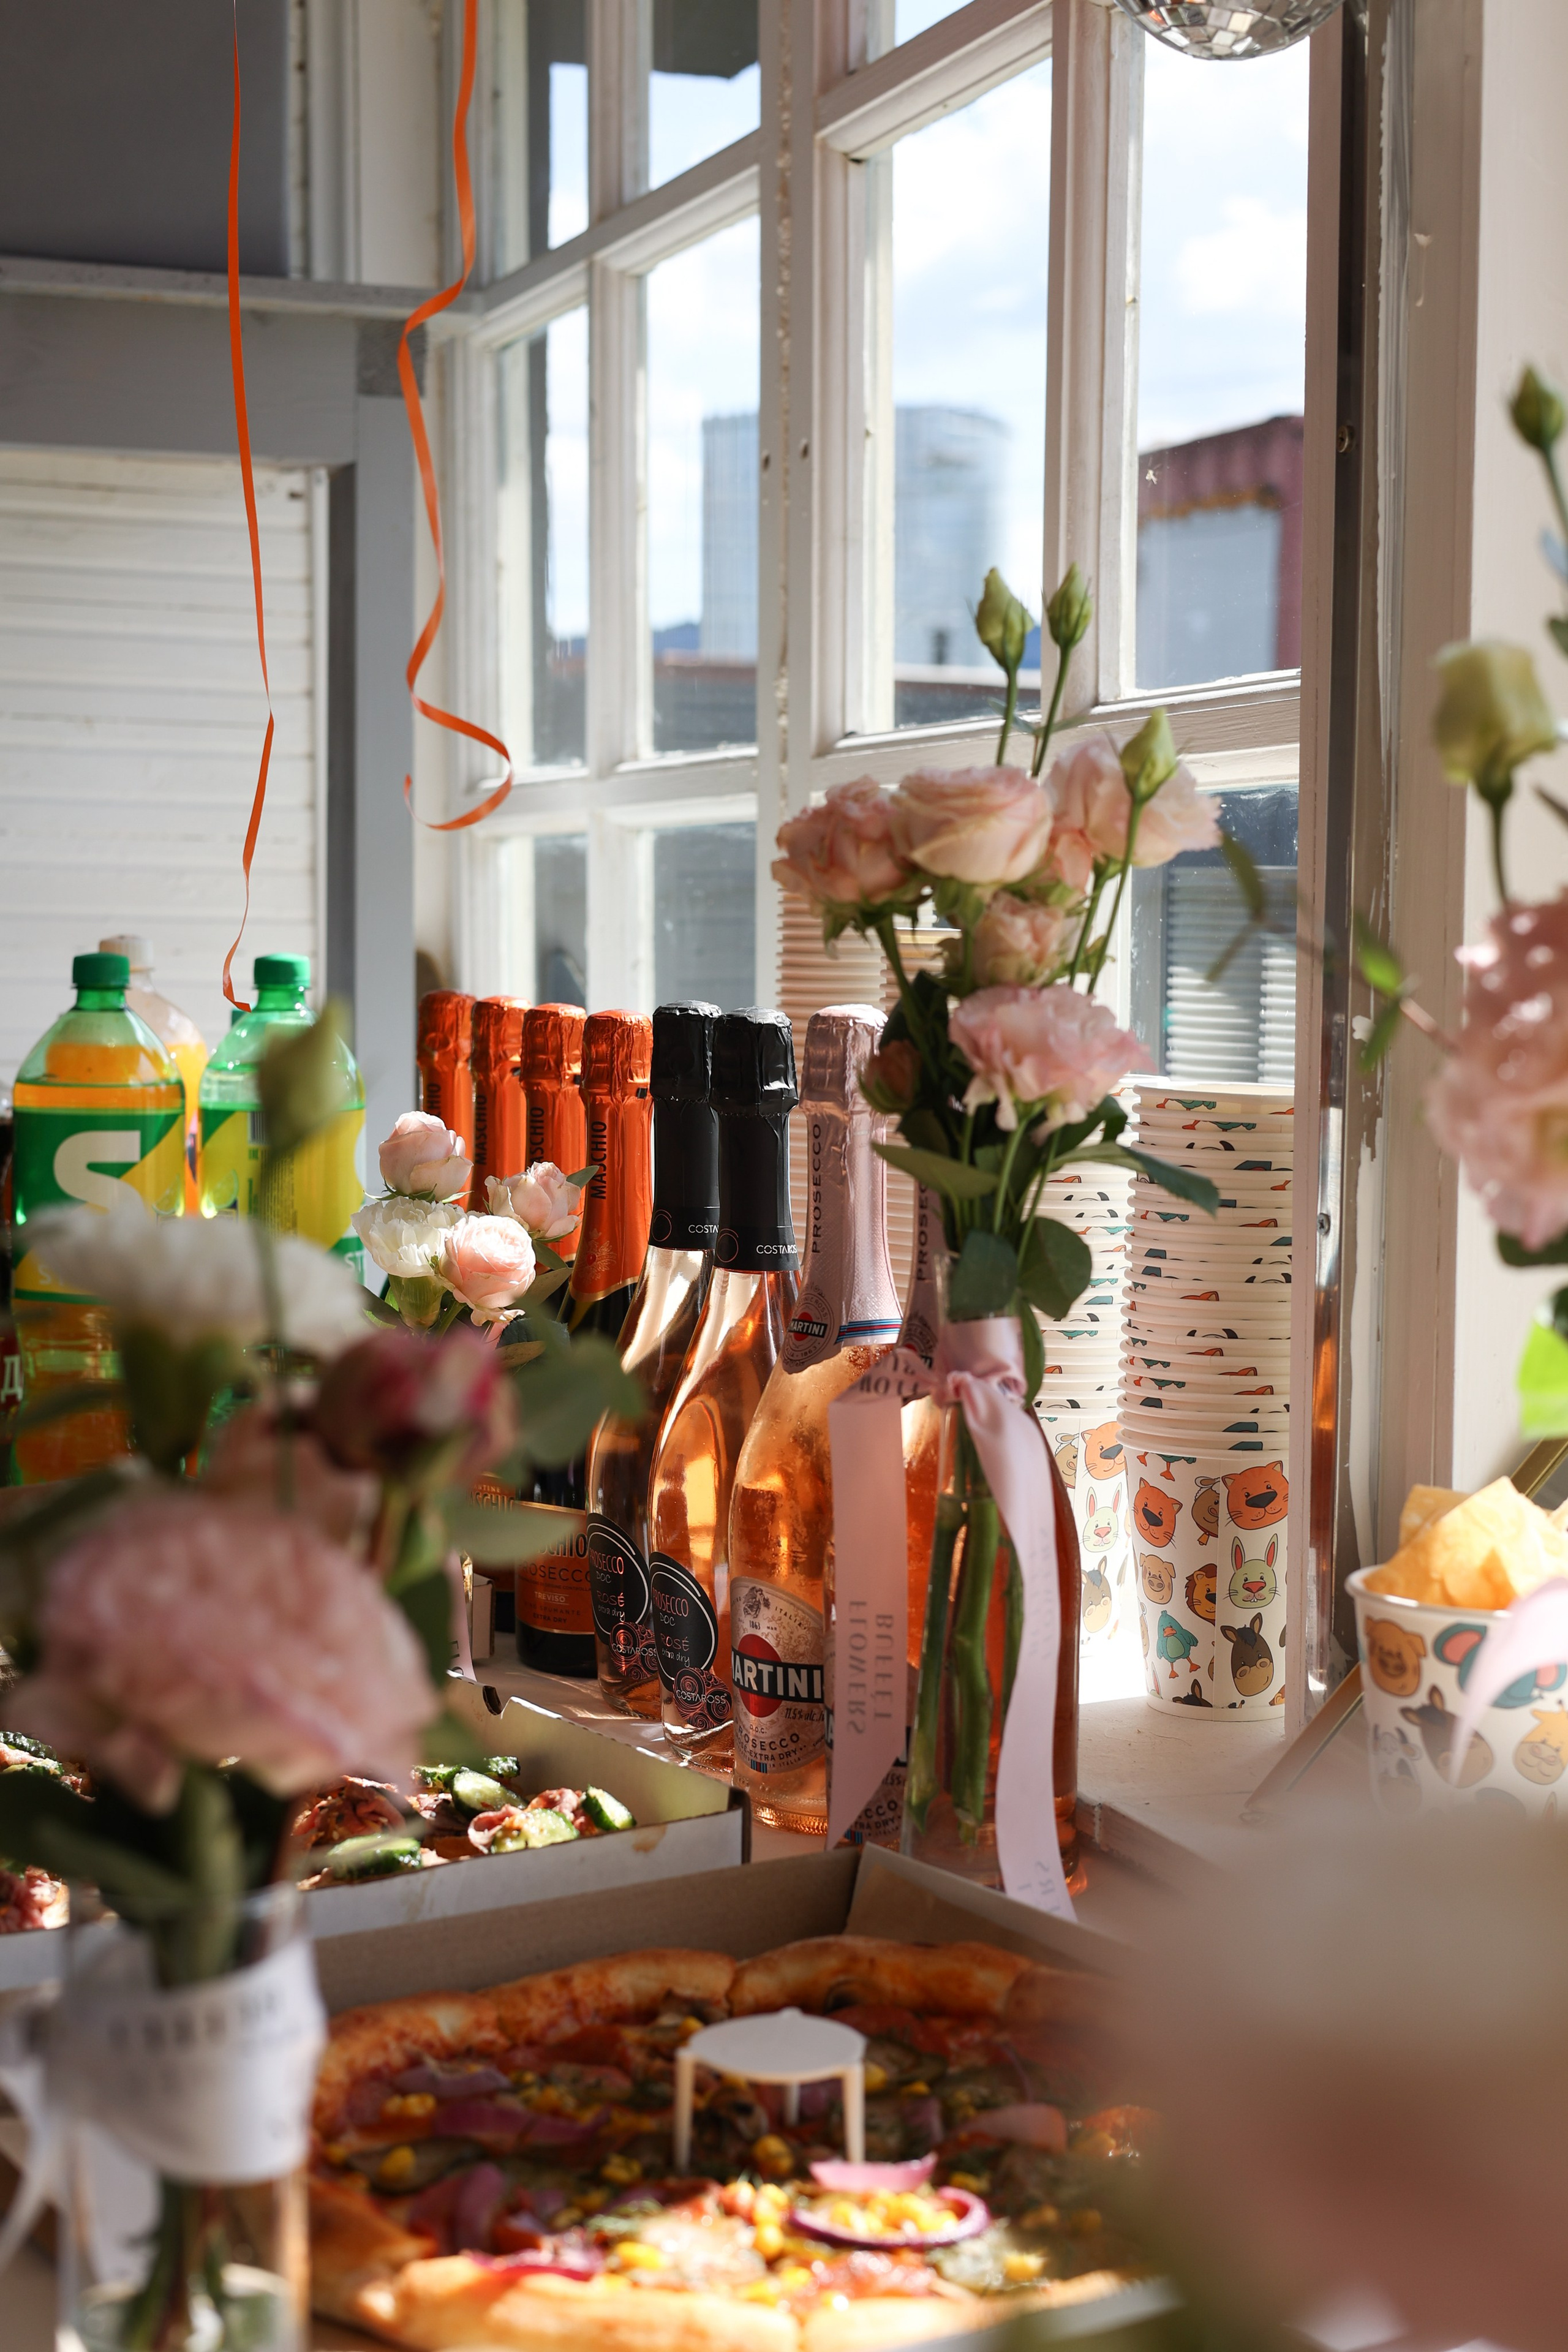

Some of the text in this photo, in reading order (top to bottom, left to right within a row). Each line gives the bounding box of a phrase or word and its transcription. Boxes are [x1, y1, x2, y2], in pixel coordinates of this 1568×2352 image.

[475, 1095, 488, 1166] MASCHIO
[812, 1124, 822, 1254] PROSECCO
[688, 1224, 719, 1234] COSTA
[756, 1244, 797, 1254] COSTAROS
[589, 1547, 625, 1575] PROSECCO
[596, 1571, 612, 1584] DOC
[534, 1591, 566, 1603] TREVISO
[597, 1591, 625, 1614] ROSÉ
[652, 1586, 689, 1618] PROSECCO
[552, 1615, 567, 1624] DRY
[612, 1606, 625, 1623] dry
[659, 1612, 676, 1626] DOC
[774, 1605, 803, 1627] ITALIA
[748, 1619, 761, 1630] 1863
[660, 1632, 690, 1653] ROSÉ
[676, 1651, 691, 1668] dry
[778, 1748, 797, 1761] DRY
